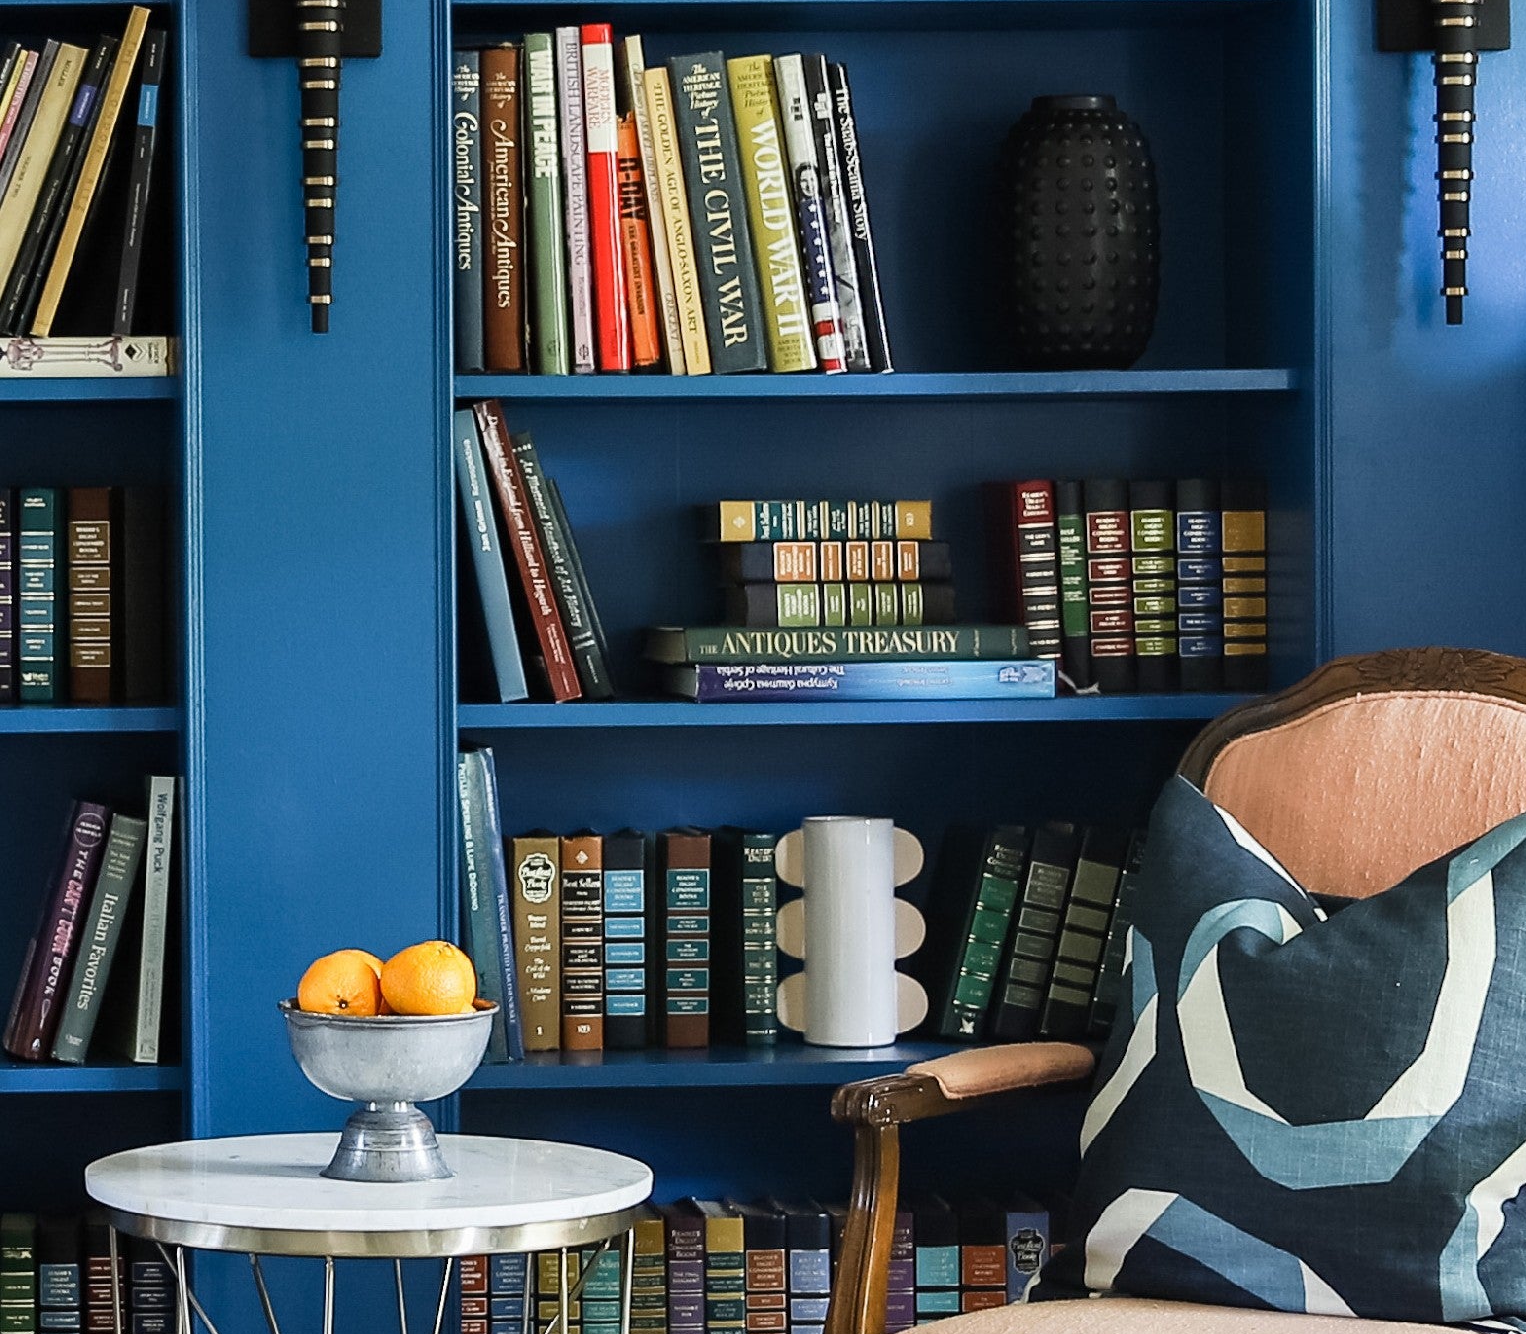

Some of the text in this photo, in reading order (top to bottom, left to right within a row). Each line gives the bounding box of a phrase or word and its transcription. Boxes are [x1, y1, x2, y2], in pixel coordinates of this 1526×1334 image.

[528, 49, 559, 180] WAR IN PEACE
[586, 66, 602, 130] WARFARE
[598, 67, 611, 125] MODERN
[565, 41, 587, 267] BRITISH LANDSCAPE PAINTING
[750, 118, 793, 233] WORLD
[835, 87, 869, 241] The Saab-Scania Story
[453, 111, 480, 270] Colonial Antiques
[489, 118, 518, 309] American Antiques
[653, 82, 698, 334] THE GOLDEN AGE OF ANGLO-SAXON ART
[693, 118, 749, 350] THE CIVIL WAR
[765, 239, 801, 308] WAR
[778, 311, 804, 338] II
[509, 508, 529, 530] from
[531, 578, 552, 616] Hogarth
[557, 576, 574, 593] Art
[563, 594, 584, 628] History
[700, 630, 960, 658] THE ANTIQUES TREASURY
[717, 663, 845, 676] The Cultural Heritage of Serbia
[153, 792, 169, 845] Wolfgang
[72, 848, 90, 880] THE
[153, 844, 167, 874] Puck
[43, 956, 64, 995] BOOK
[76, 891, 120, 1011] Italian Favorites
